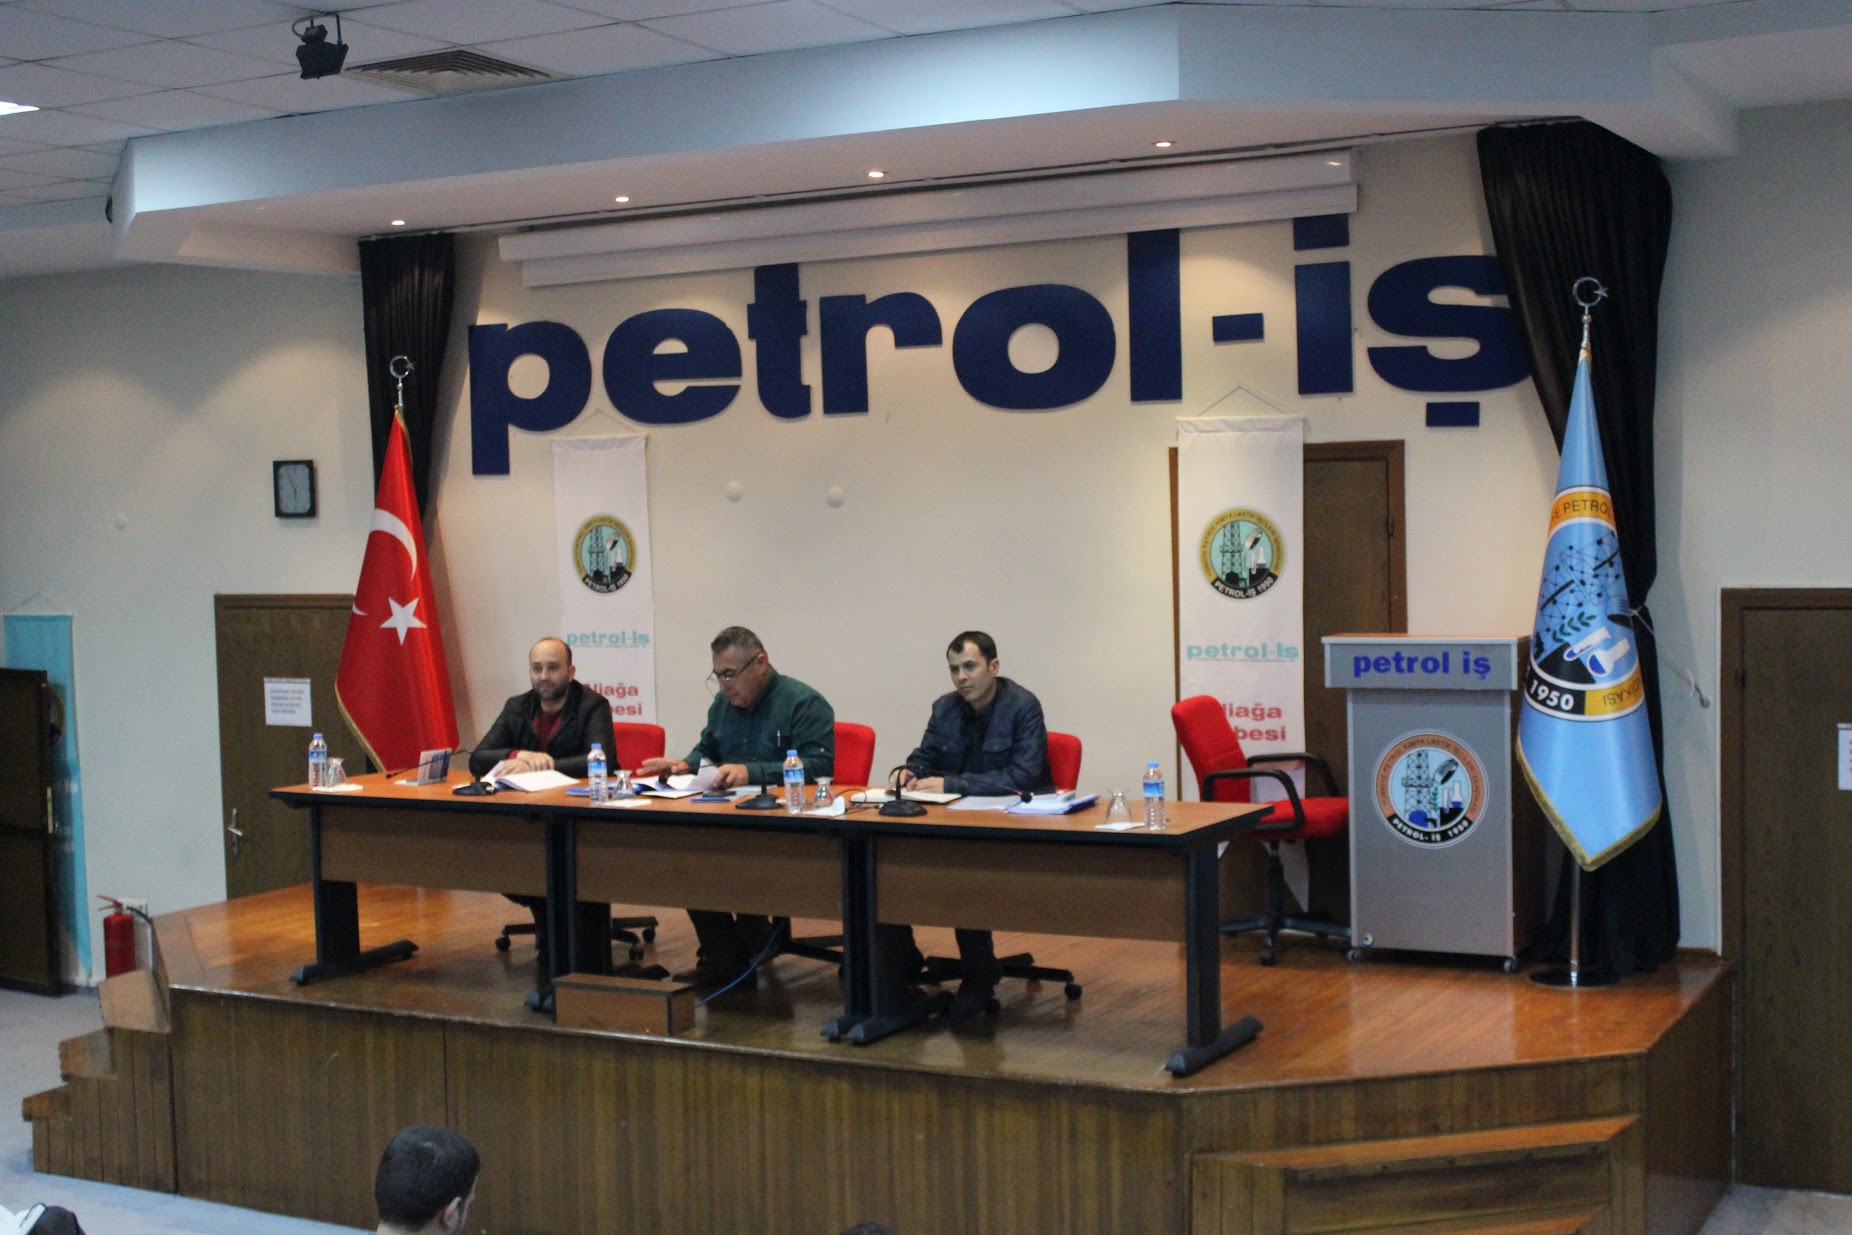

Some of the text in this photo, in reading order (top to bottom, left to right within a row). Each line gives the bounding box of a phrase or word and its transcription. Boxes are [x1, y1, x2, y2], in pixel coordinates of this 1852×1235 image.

[468, 214, 1533, 475] petrol-iş
[1353, 651, 1491, 680] petrol iş
[1529, 679, 1575, 711] 1950
[1222, 702, 1283, 722] liağa
[1234, 725, 1287, 742] besi
